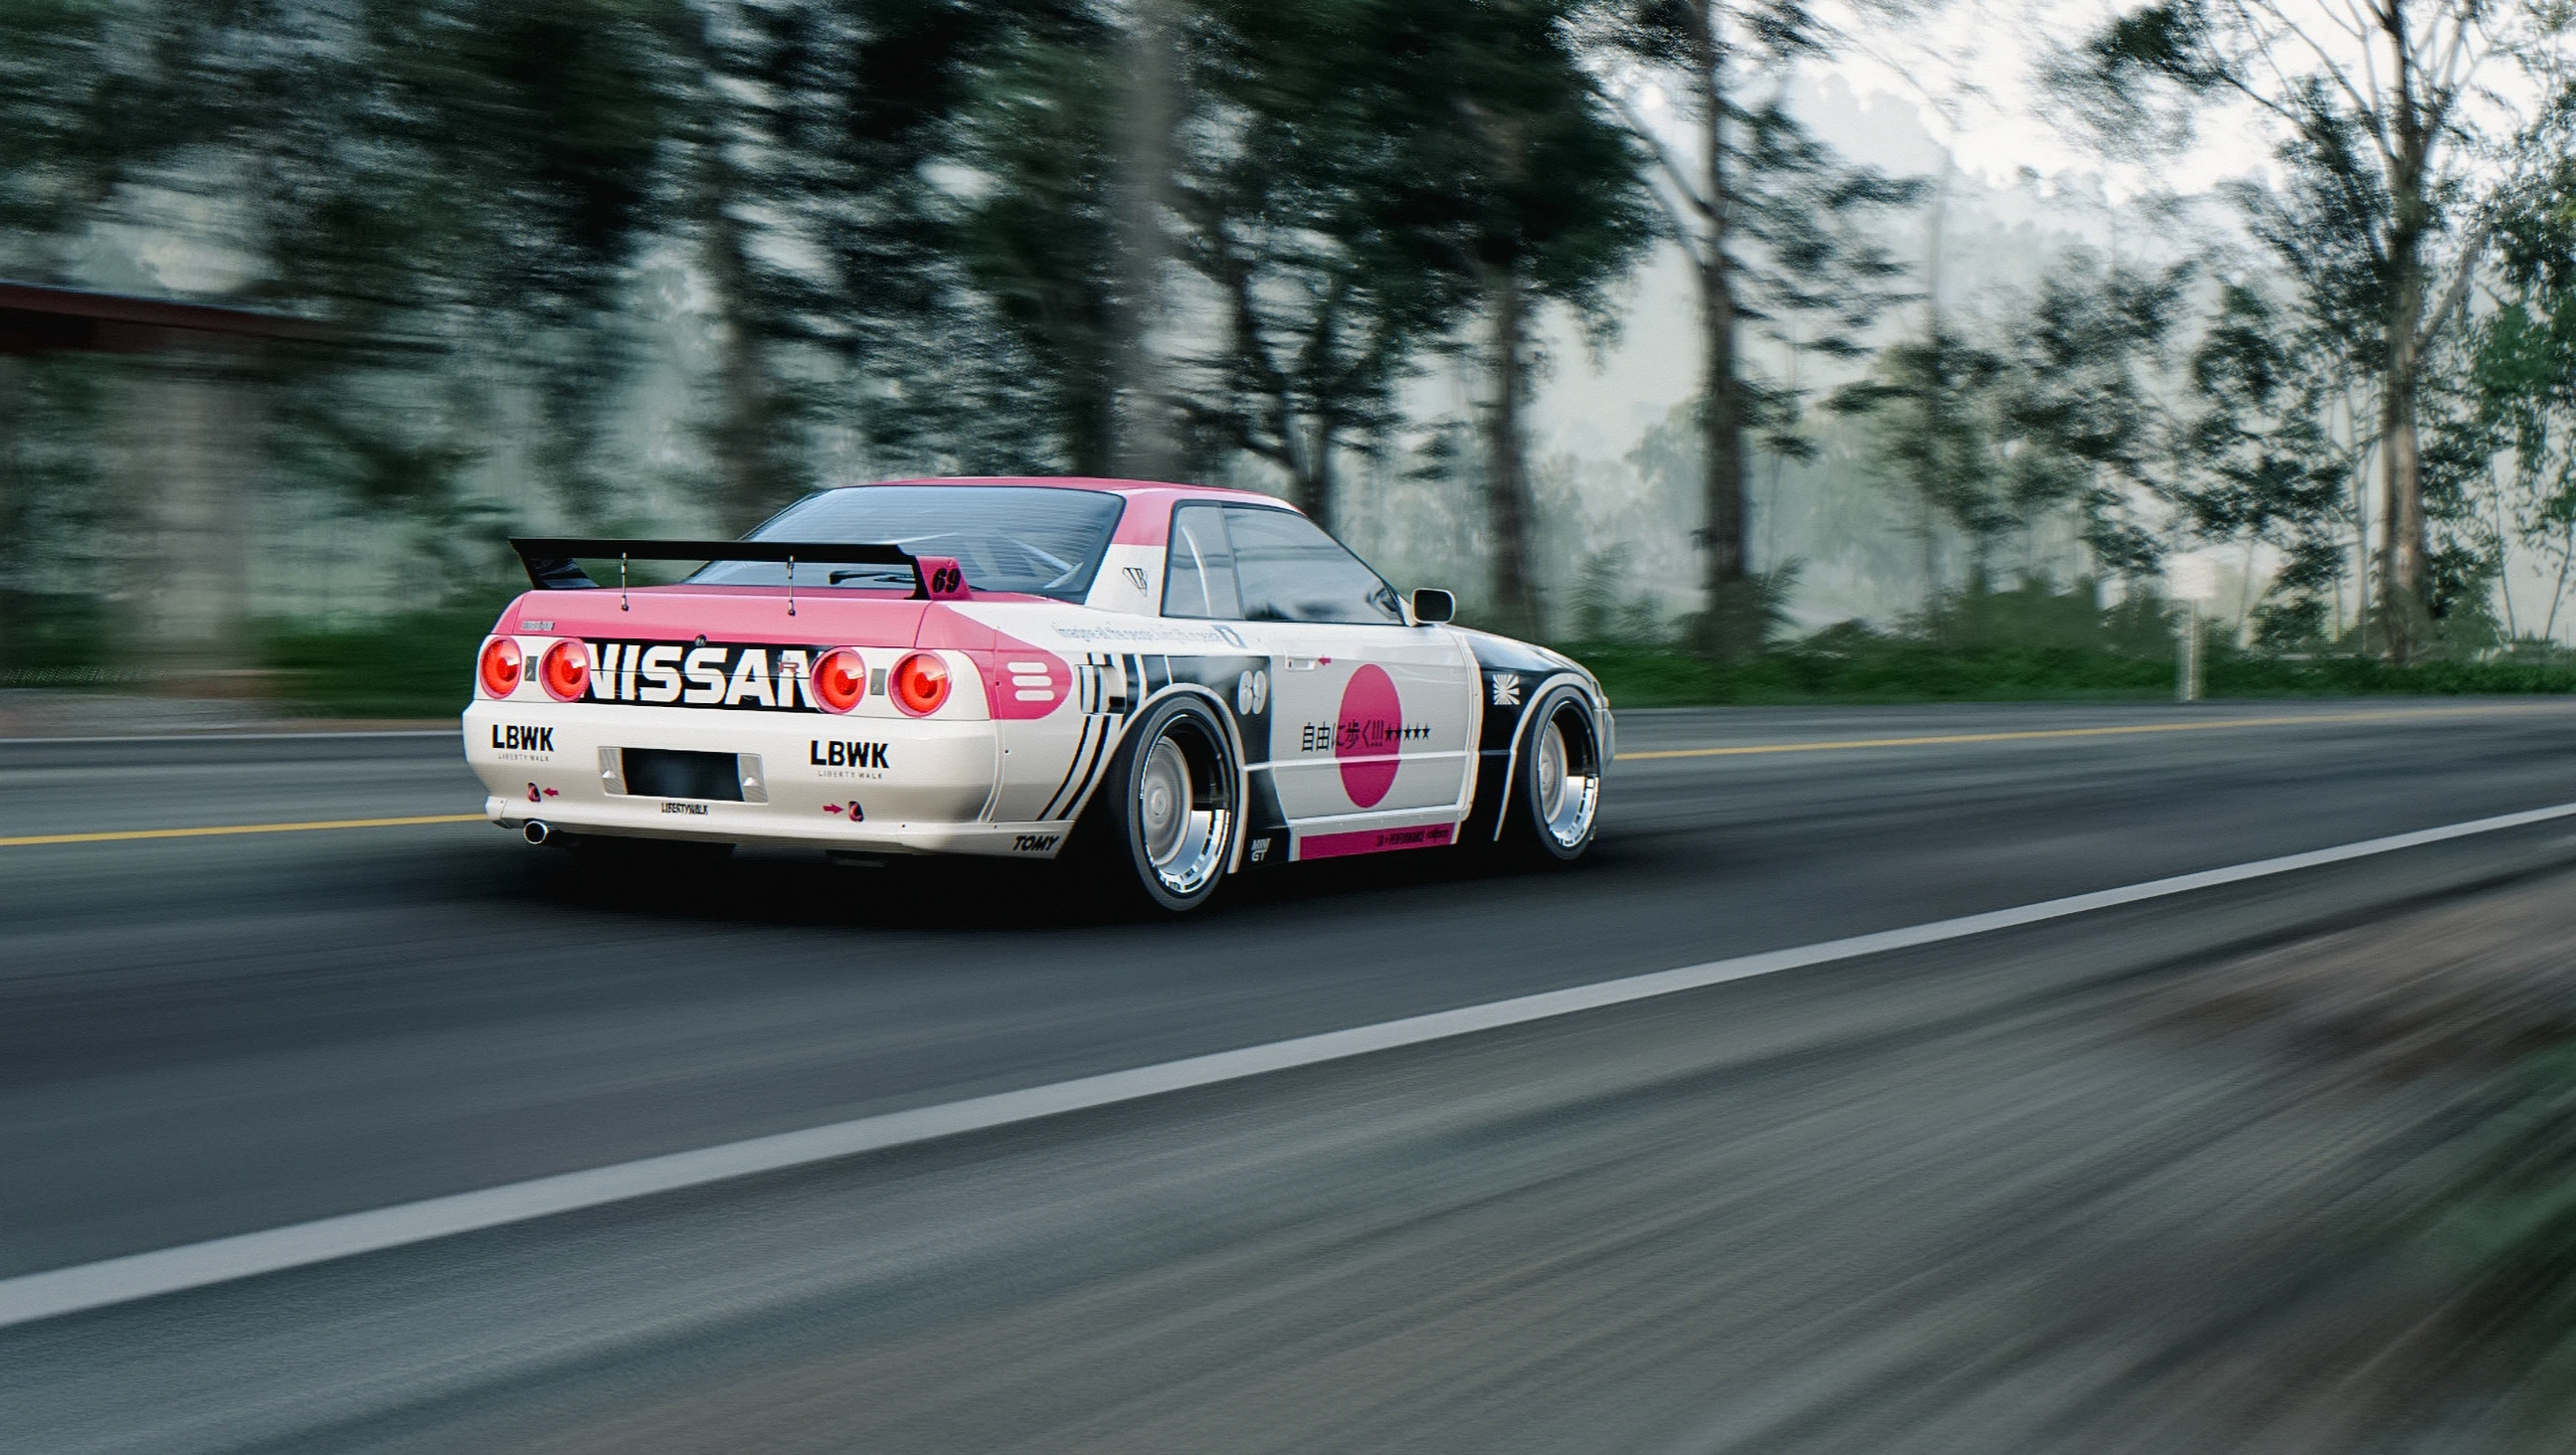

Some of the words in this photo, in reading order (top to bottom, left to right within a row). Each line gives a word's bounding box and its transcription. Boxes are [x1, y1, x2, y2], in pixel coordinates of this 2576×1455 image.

[932, 567, 962, 594] 69
[582, 642, 821, 708] NISSAN
[1237, 669, 1267, 715] 69
[491, 724, 555, 752] LBWK
[810, 740, 890, 769] LBWK
[818, 770, 855, 779] LIBERTY
[1012, 834, 1060, 851] TOMY
[1251, 849, 1268, 862] GT
